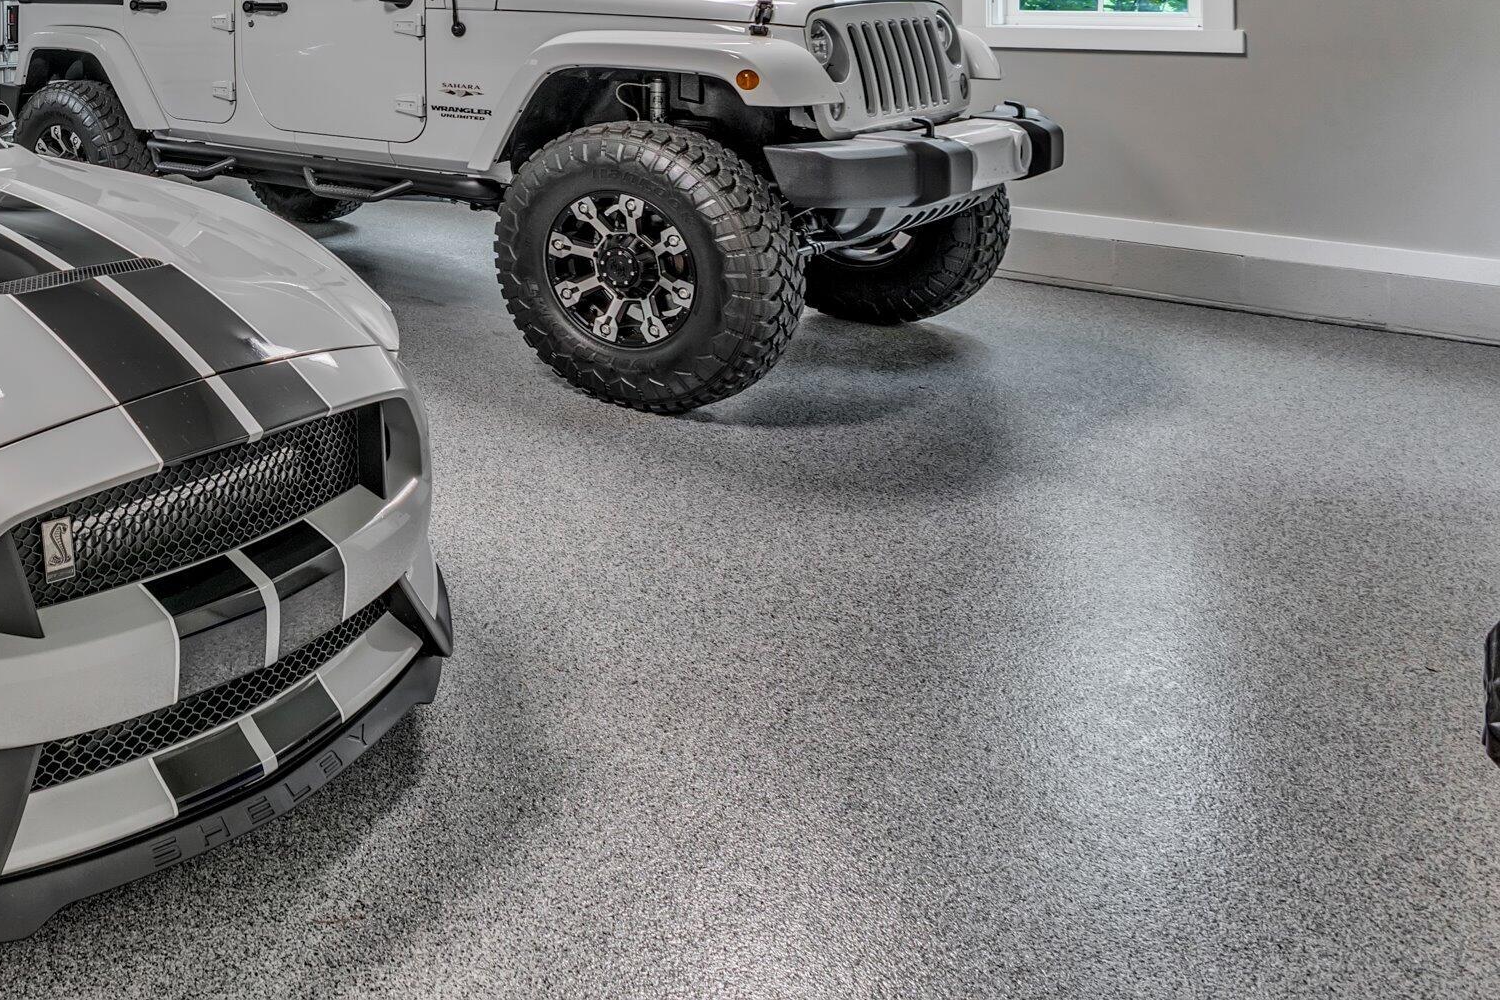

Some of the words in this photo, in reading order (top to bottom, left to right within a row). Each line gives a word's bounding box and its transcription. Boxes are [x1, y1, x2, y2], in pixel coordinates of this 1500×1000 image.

[442, 82, 481, 90] SAHARA
[431, 105, 492, 116] WRANGLER
[441, 113, 485, 121] UNLIMITED
[150, 723, 369, 868] SHELBY
